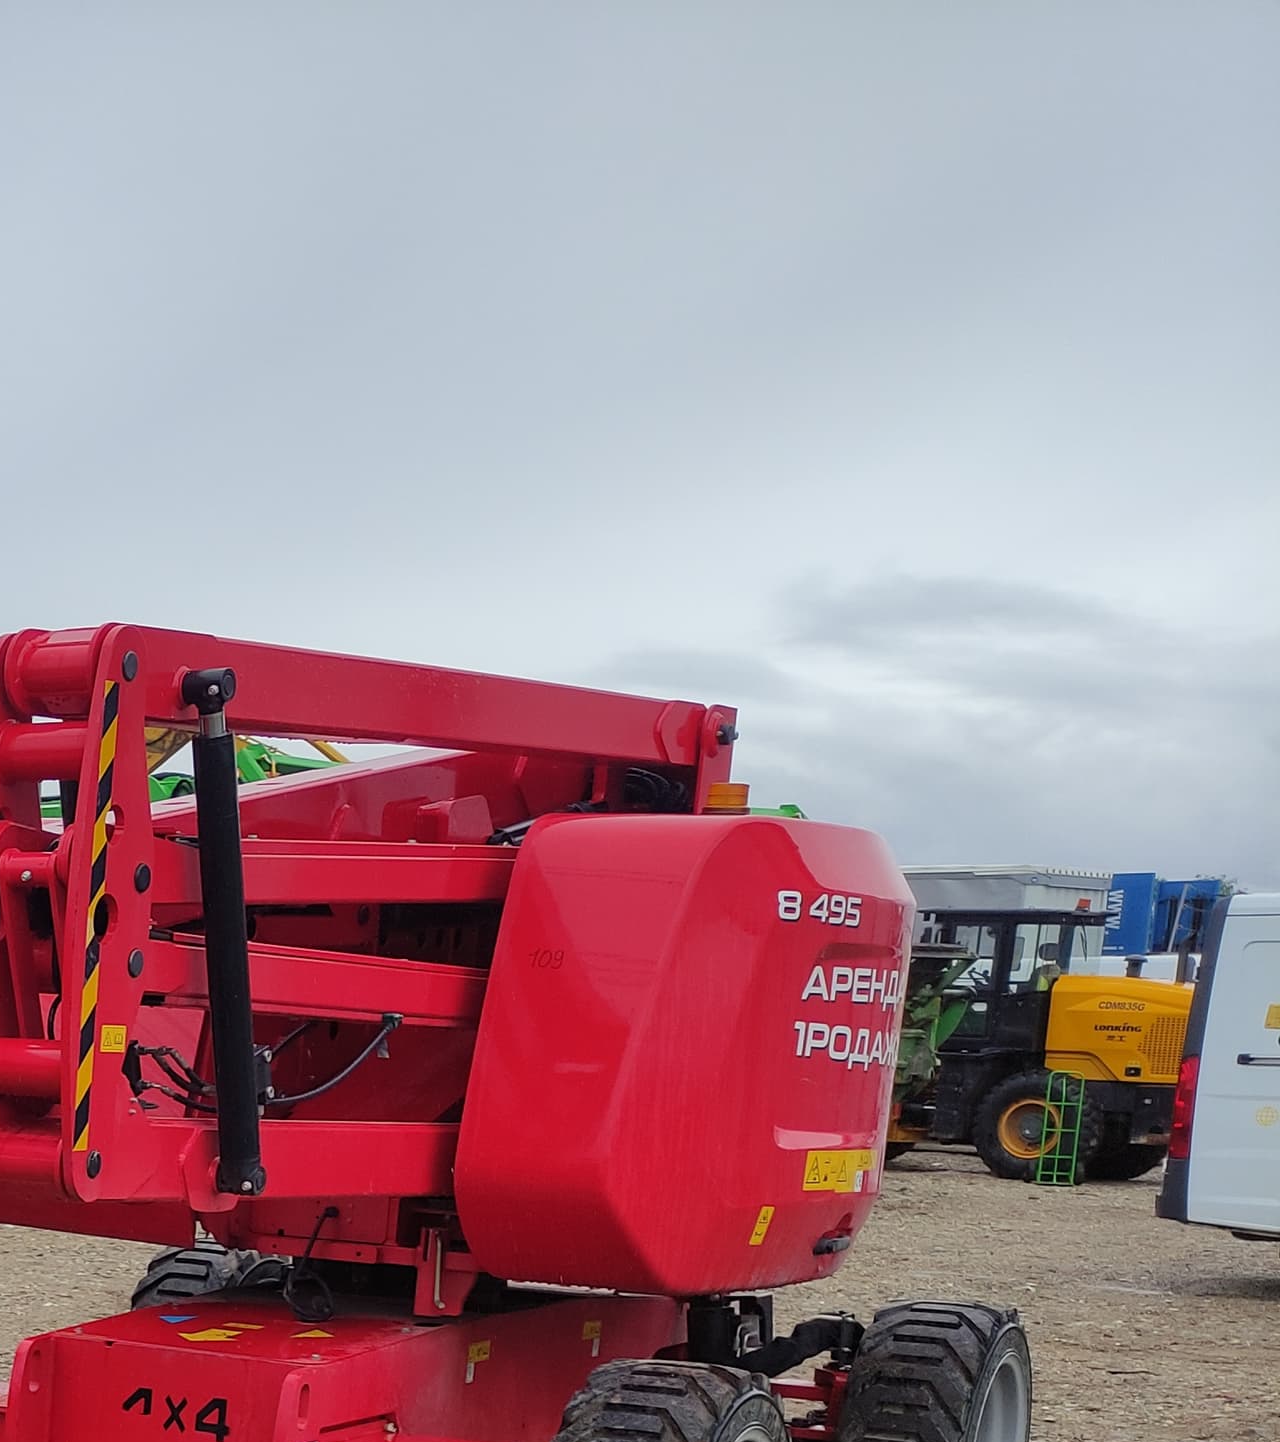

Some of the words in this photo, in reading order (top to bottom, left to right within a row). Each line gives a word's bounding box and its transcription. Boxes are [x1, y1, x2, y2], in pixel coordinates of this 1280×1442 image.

[778, 890, 802, 921] 8
[809, 894, 862, 927] 495
[528, 947, 565, 970] 109
[1098, 1001, 1146, 1012] CDM835G
